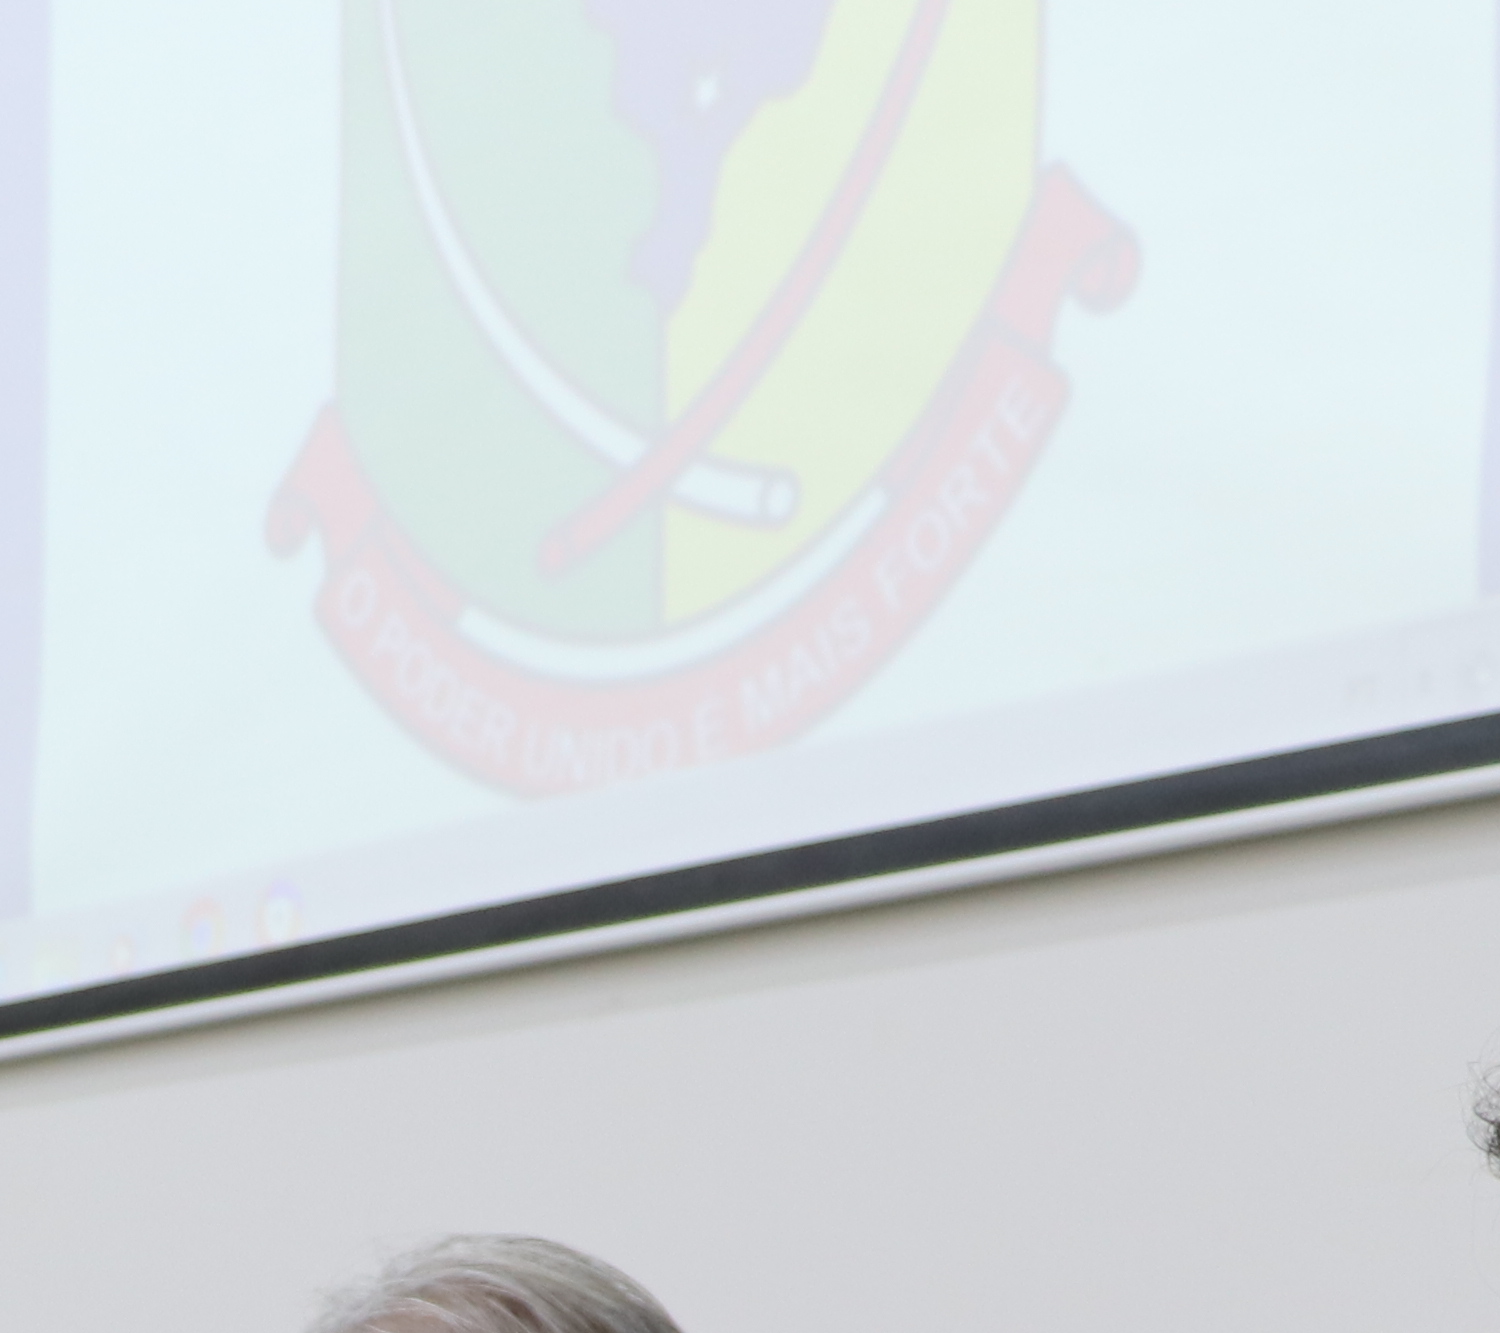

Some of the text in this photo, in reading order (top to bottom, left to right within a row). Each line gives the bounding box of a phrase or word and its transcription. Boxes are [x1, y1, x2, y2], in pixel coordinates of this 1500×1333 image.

[372, 608, 512, 764] PODER
[522, 716, 679, 786] UNIDO
[735, 595, 875, 735] MAIS
[871, 373, 1047, 615] FORTE
